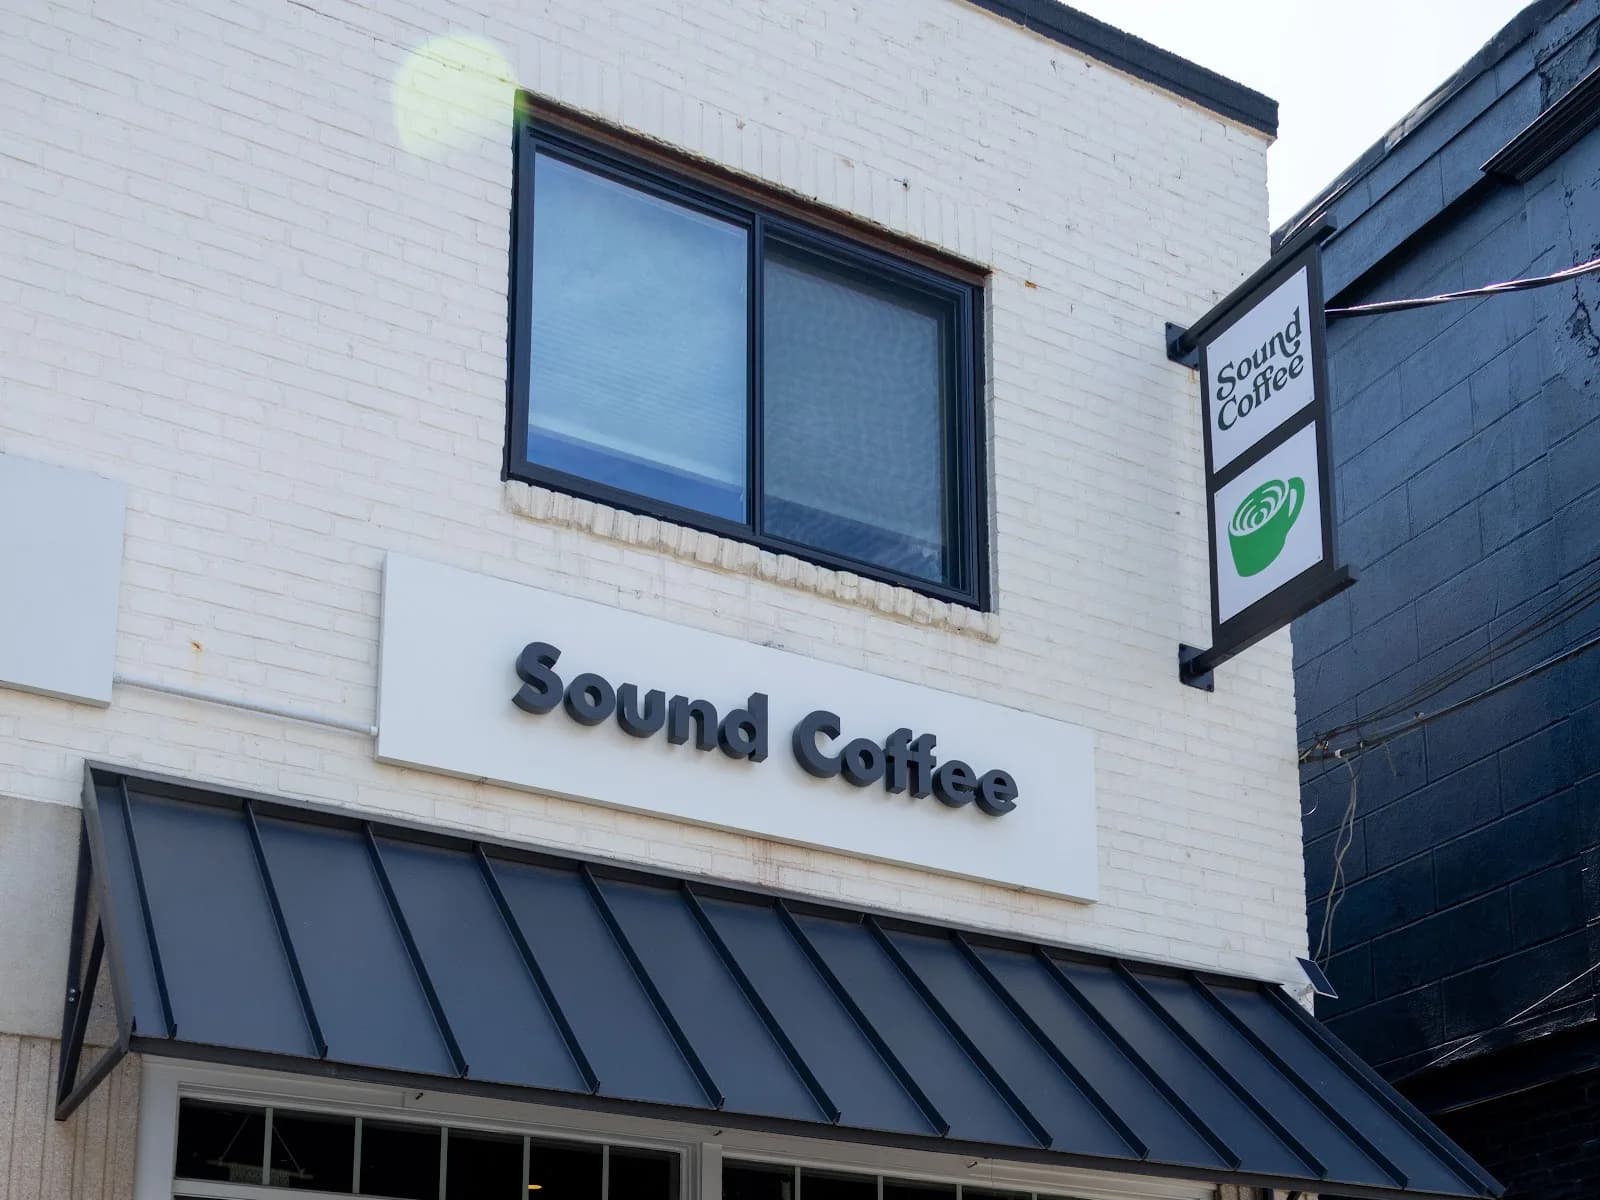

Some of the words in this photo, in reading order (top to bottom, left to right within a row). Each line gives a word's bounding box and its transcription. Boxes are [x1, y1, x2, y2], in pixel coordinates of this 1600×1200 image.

[1216, 306, 1303, 401] Sound
[1216, 353, 1305, 431] Coffee
[511, 641, 769, 763] Sound
[791, 710, 1019, 818] Coffee
